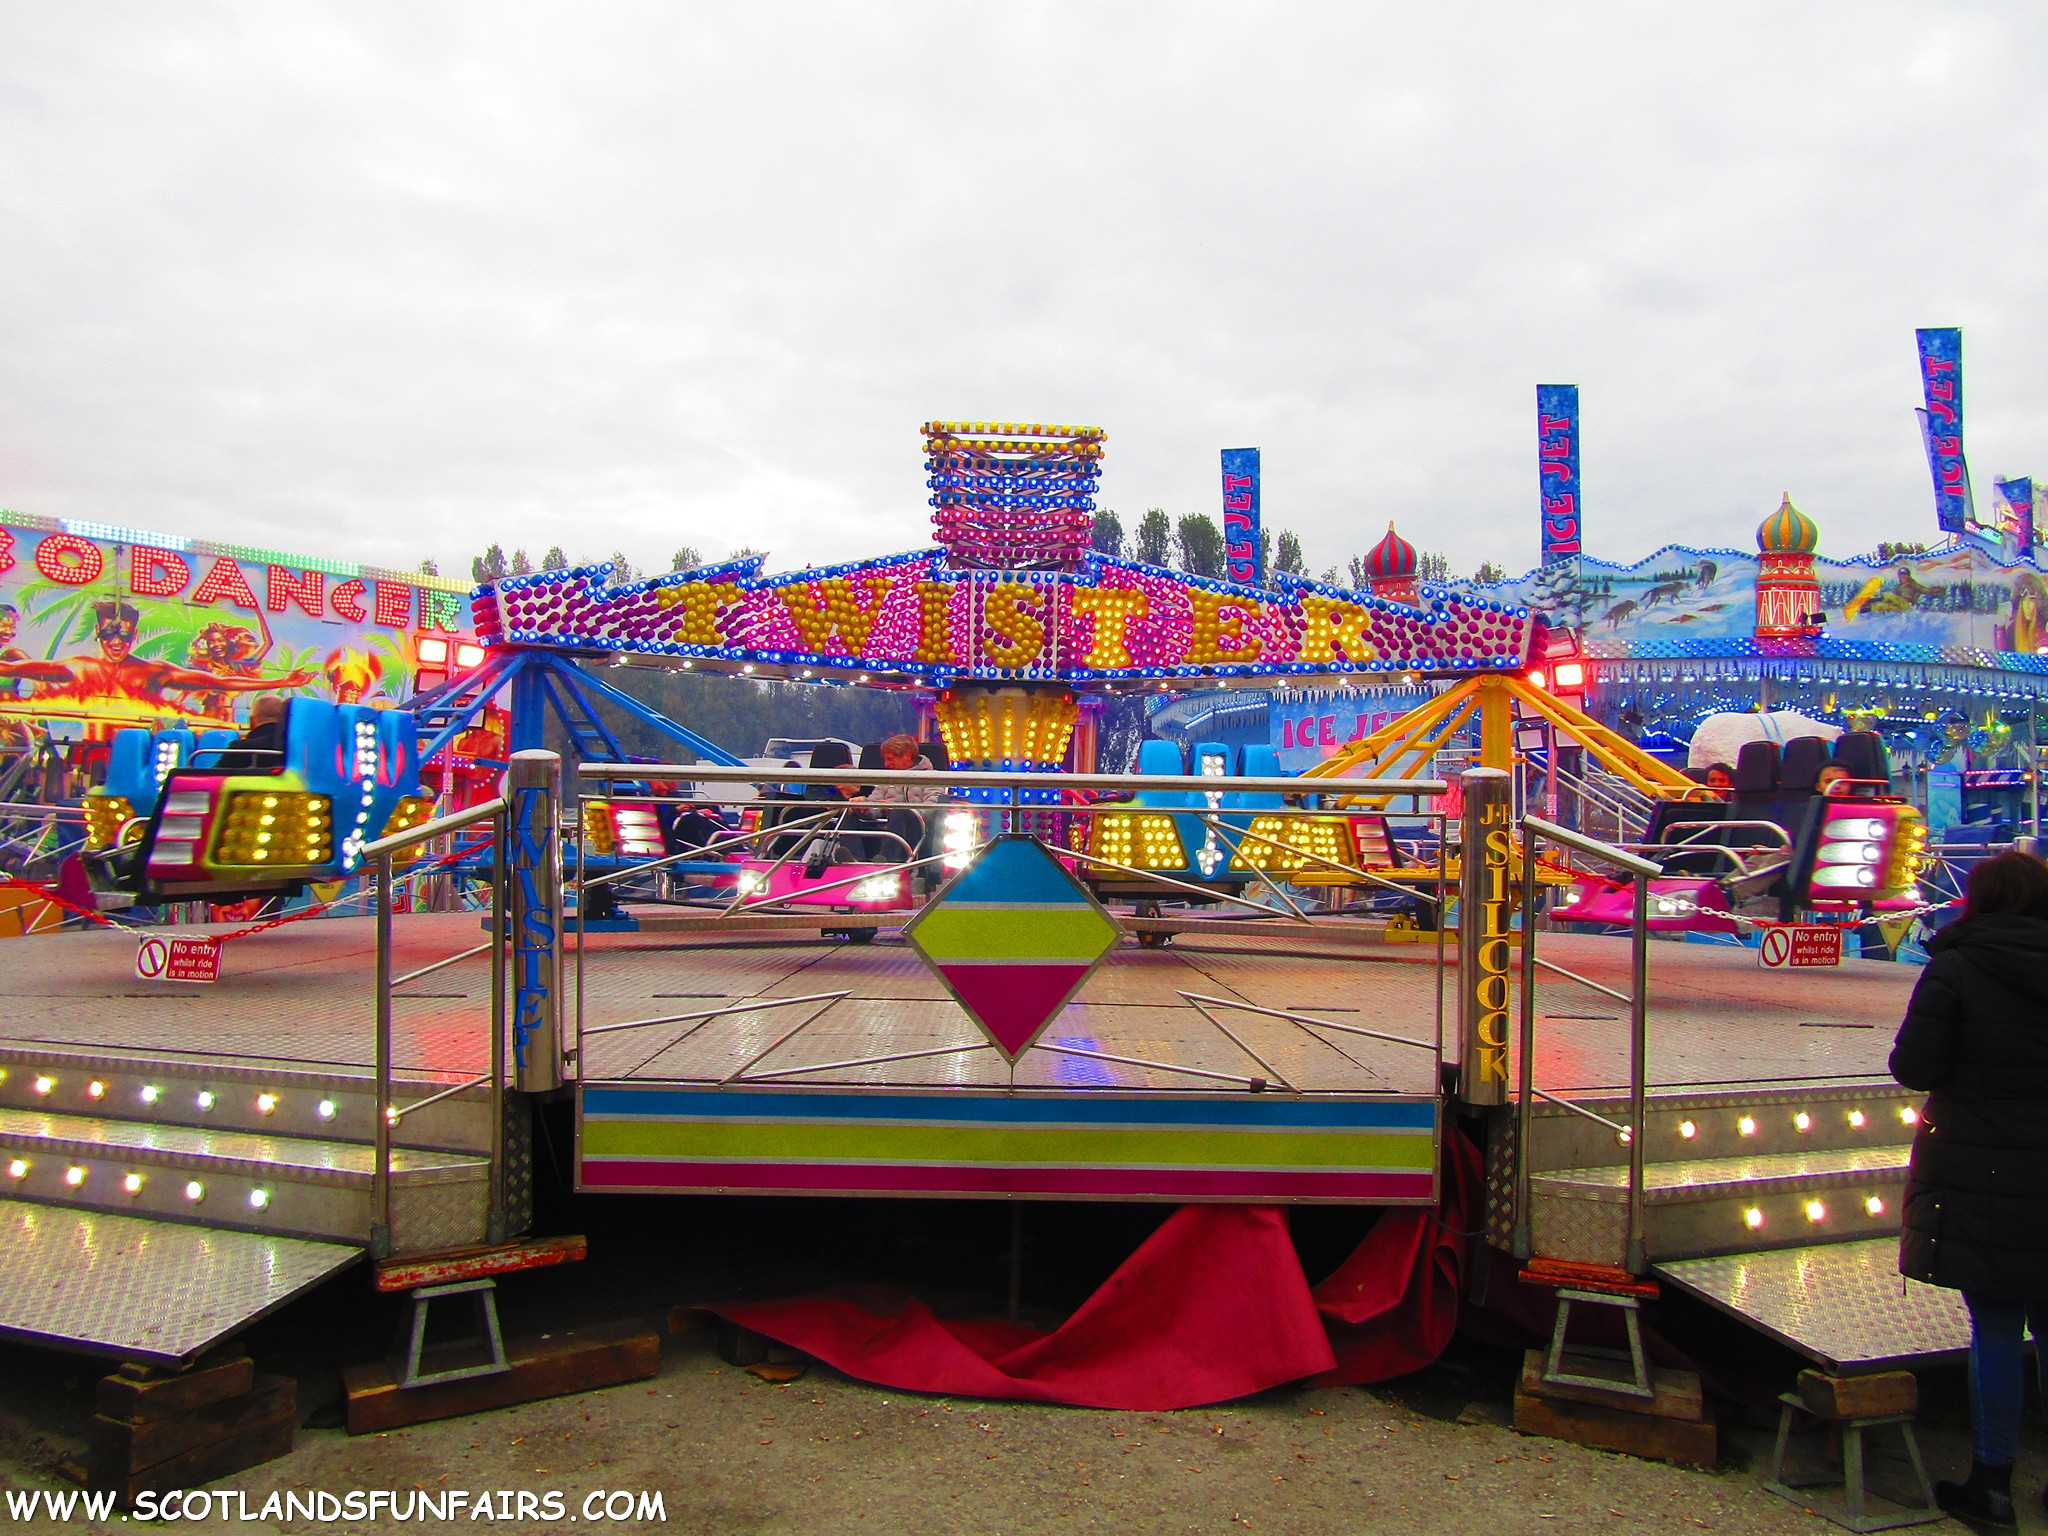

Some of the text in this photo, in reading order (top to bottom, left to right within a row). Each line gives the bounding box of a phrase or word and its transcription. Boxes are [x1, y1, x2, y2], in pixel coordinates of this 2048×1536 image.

[1925, 355, 1965, 497] ICE JET
[1540, 414, 1581, 553] ICE JET
[1224, 473, 1255, 588] CE JET
[131, 545, 463, 634] DANCER
[655, 578, 1375, 669] TWISTER
[1282, 713, 1338, 750] ICE
[173, 943, 218, 957] No entry
[1795, 931, 1838, 944] No entry
[1797, 945, 1835, 954] whilst ride
[168, 969, 214, 979] is in motion
[173, 958, 213, 968] whilst ride
[1476, 830, 1509, 1083] SILCOCK
[1792, 956, 1836, 965] is in motion
